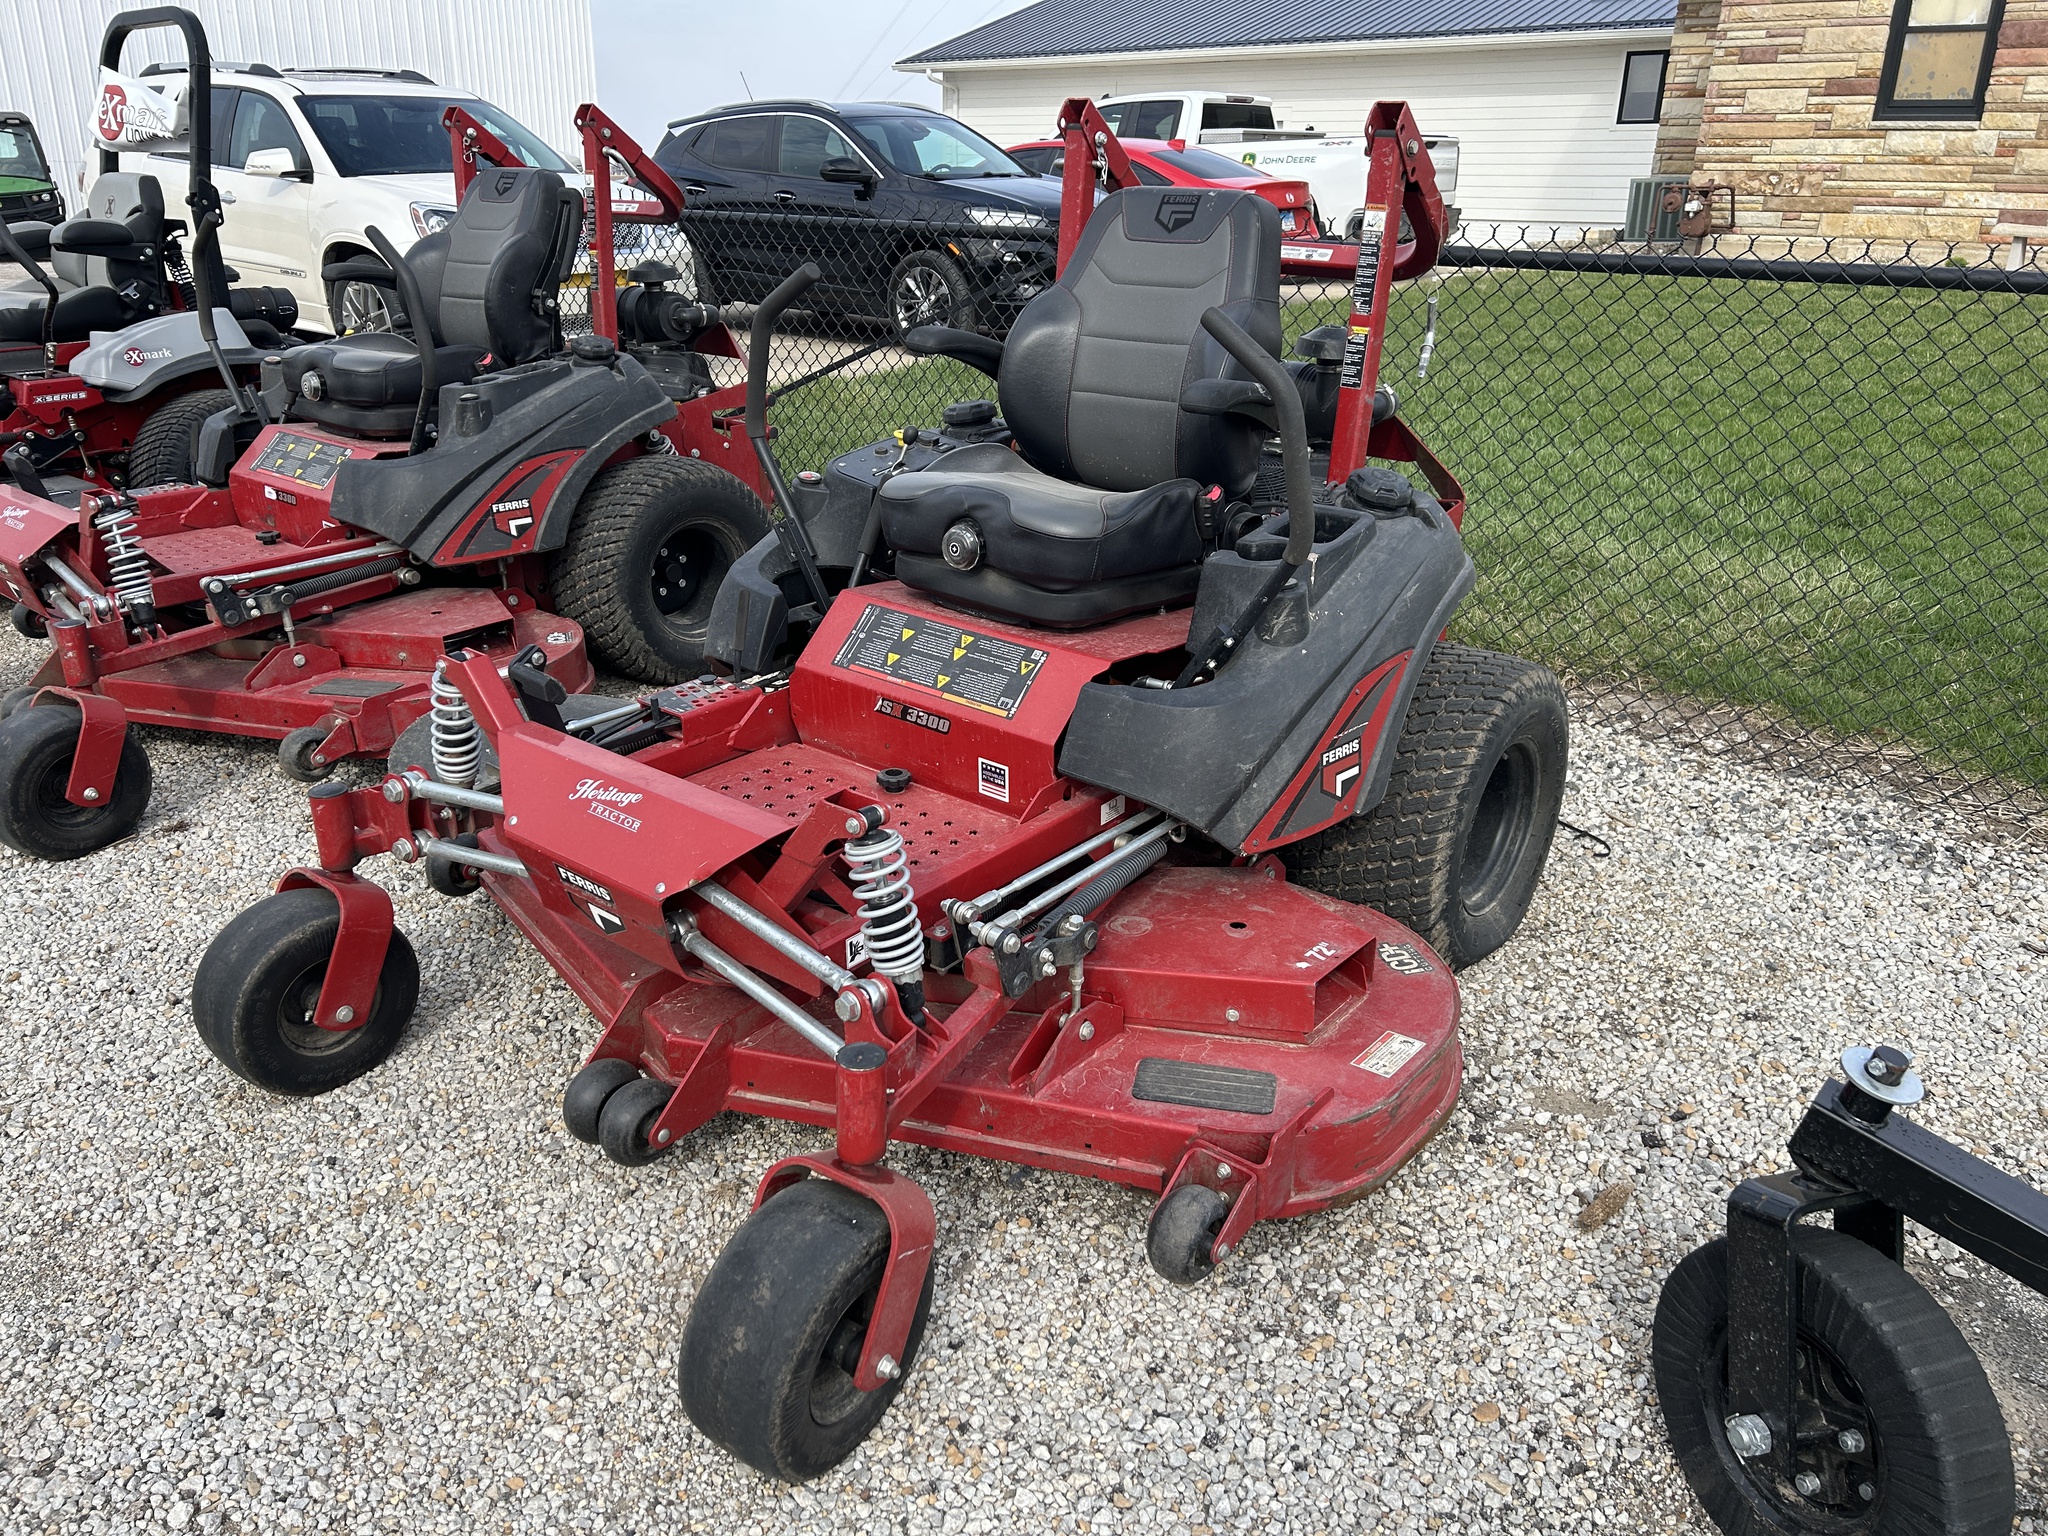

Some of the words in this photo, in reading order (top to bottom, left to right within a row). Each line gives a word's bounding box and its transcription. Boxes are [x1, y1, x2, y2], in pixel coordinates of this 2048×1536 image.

[1259, 156, 1284, 164] JOHN
[1285, 155, 1317, 164] DEERE
[1164, 195, 1199, 203] FERRIS
[278, 491, 297, 505] 3300
[492, 499, 530, 513] FERRIS
[906, 708, 950, 732] 3300
[1322, 738, 1360, 766] FERRIS
[568, 778, 643, 807] Heritage
[589, 802, 641, 831] TRACTOR
[557, 866, 611, 901] FERRIS
